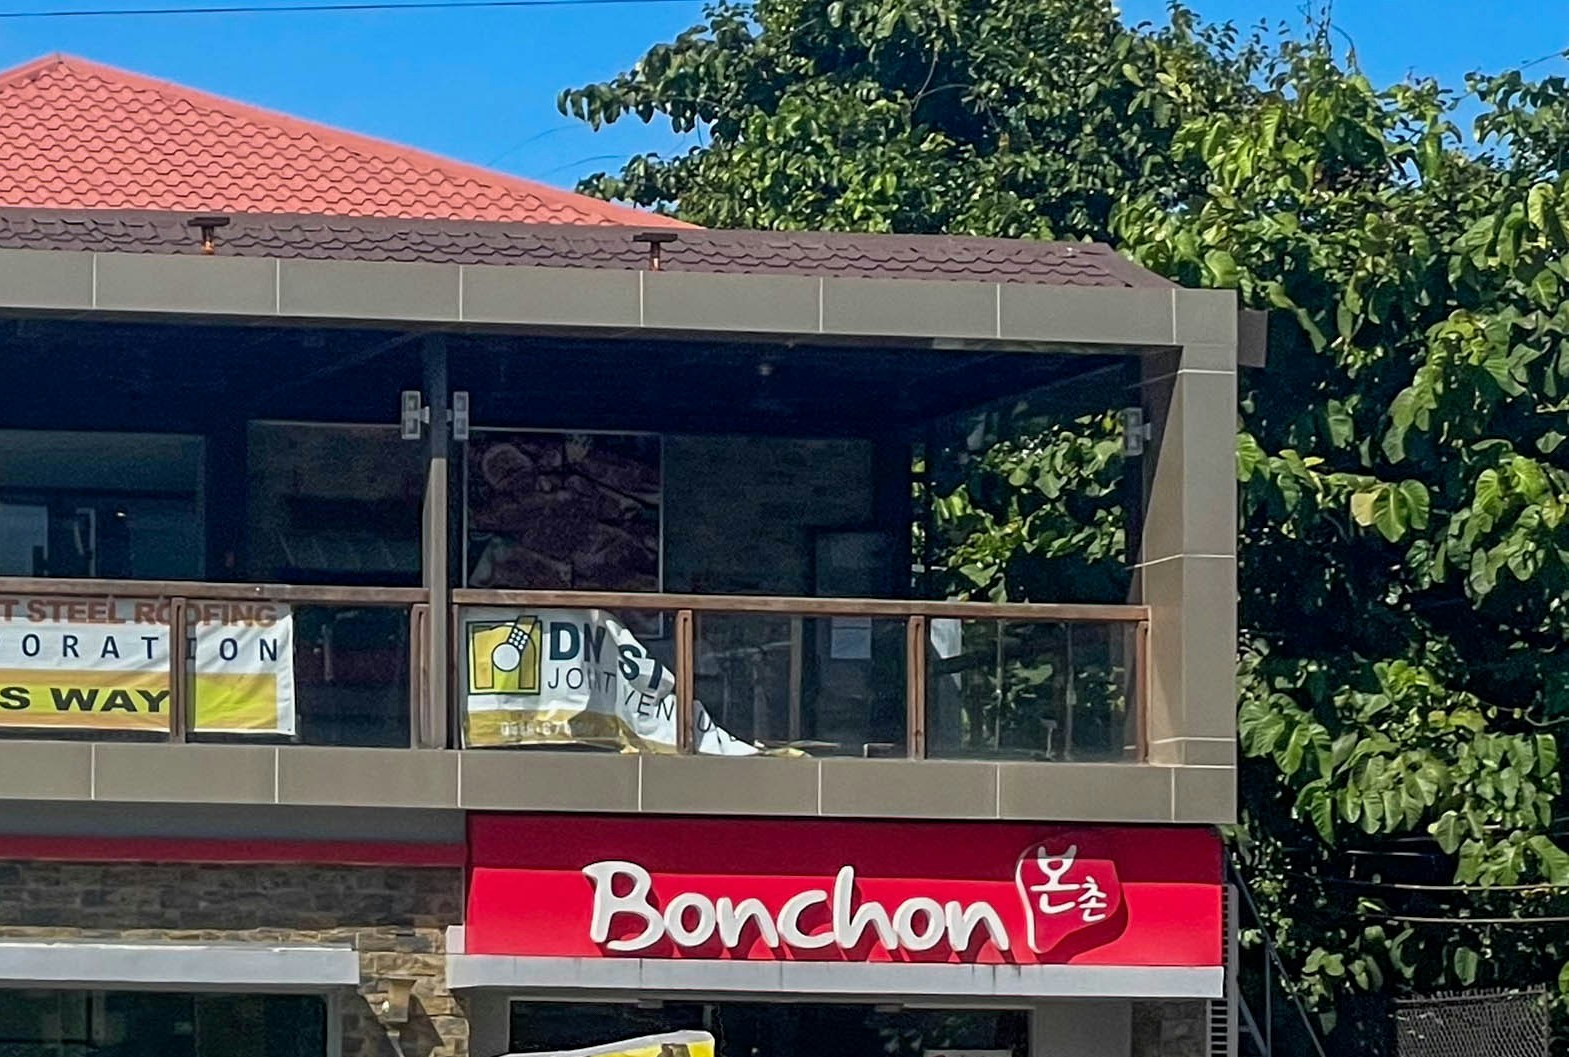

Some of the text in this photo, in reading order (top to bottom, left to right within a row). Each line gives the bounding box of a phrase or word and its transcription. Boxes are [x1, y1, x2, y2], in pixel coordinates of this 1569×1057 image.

[27, 600, 126, 624] STEEL
[550, 622, 605, 664] DN
[50, 687, 171, 714] WAY
[1030, 845, 1107, 922] 본촌
[582, 860, 1010, 952] Bonchon
